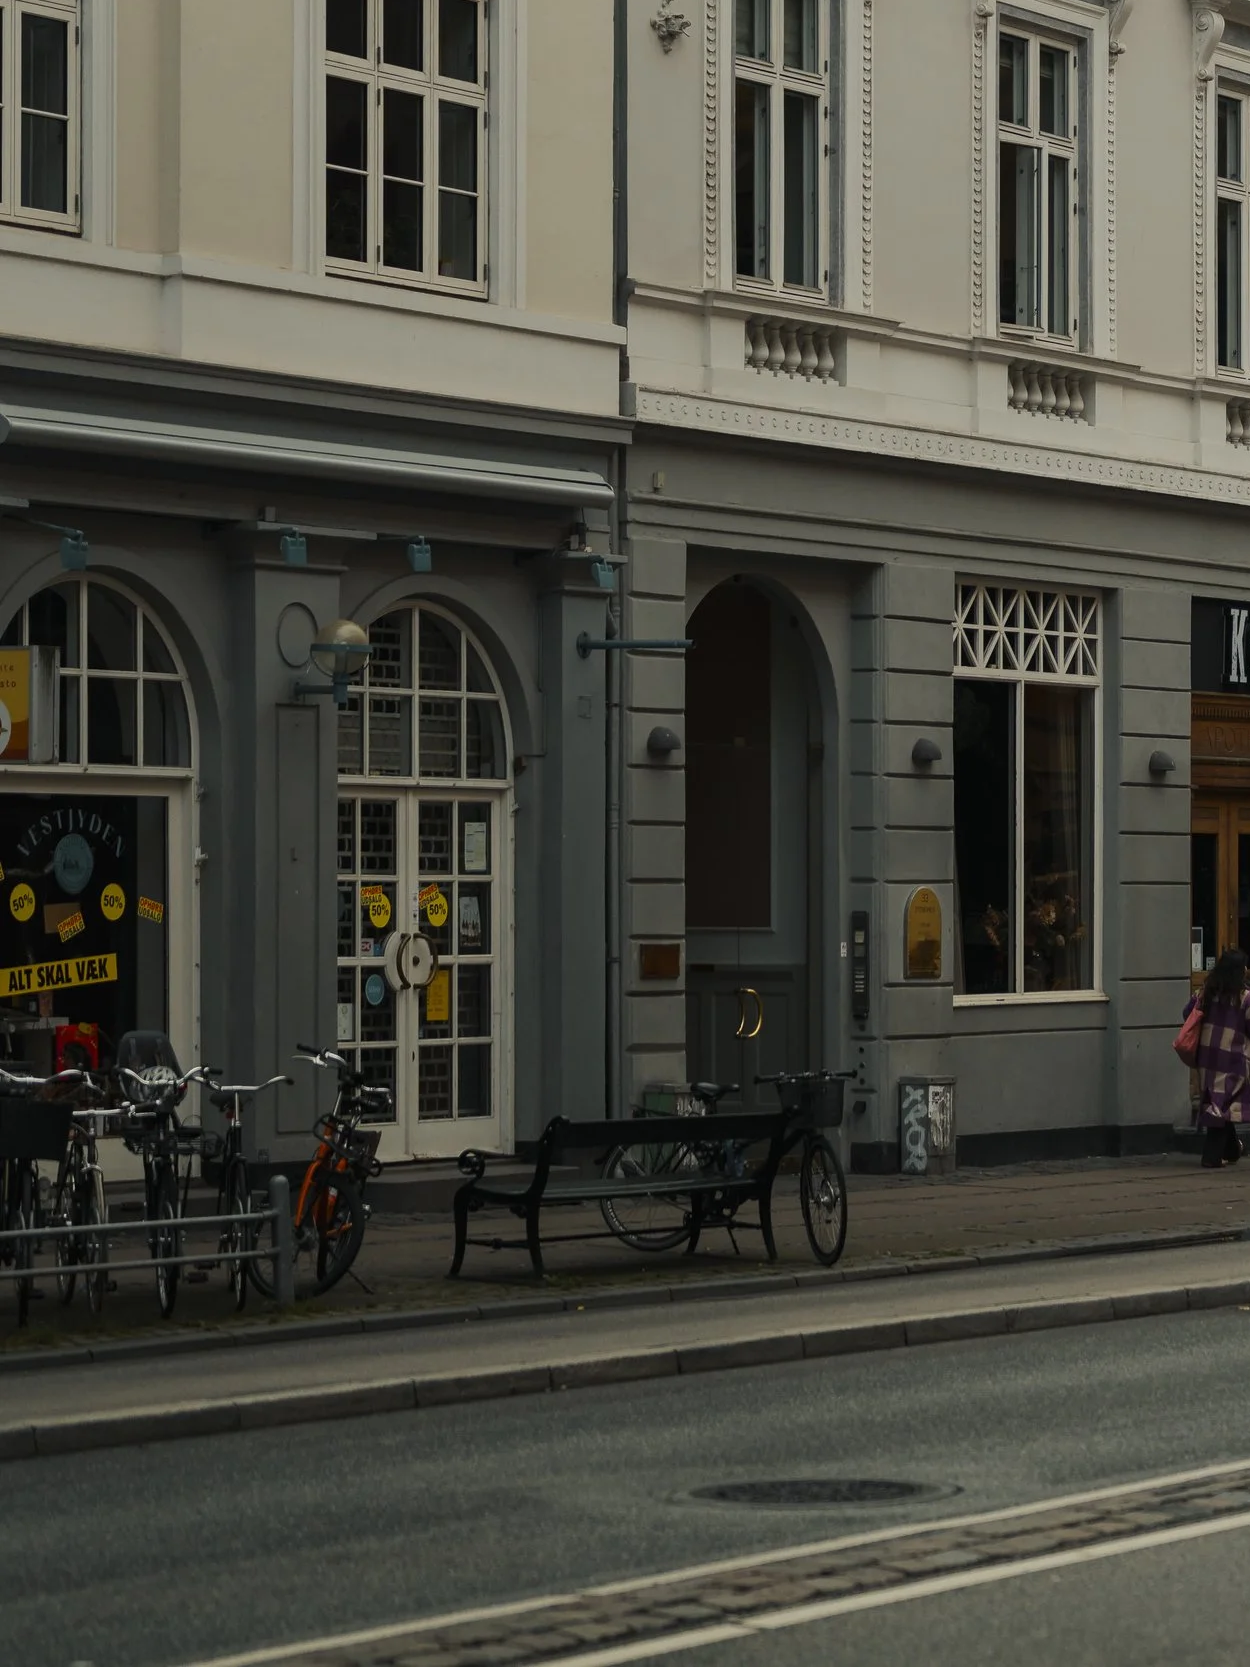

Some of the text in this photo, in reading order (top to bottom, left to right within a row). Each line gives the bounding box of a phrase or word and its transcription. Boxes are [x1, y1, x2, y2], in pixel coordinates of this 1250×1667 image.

[17, 807, 127, 859] VESTJYDEN
[12, 894, 34, 912] 50%
[103, 895, 123, 910] 50%
[371, 904, 389, 916] 50%
[429, 903, 447, 916] 50%
[8, 957, 109, 992] ALT SKAL VÆK
